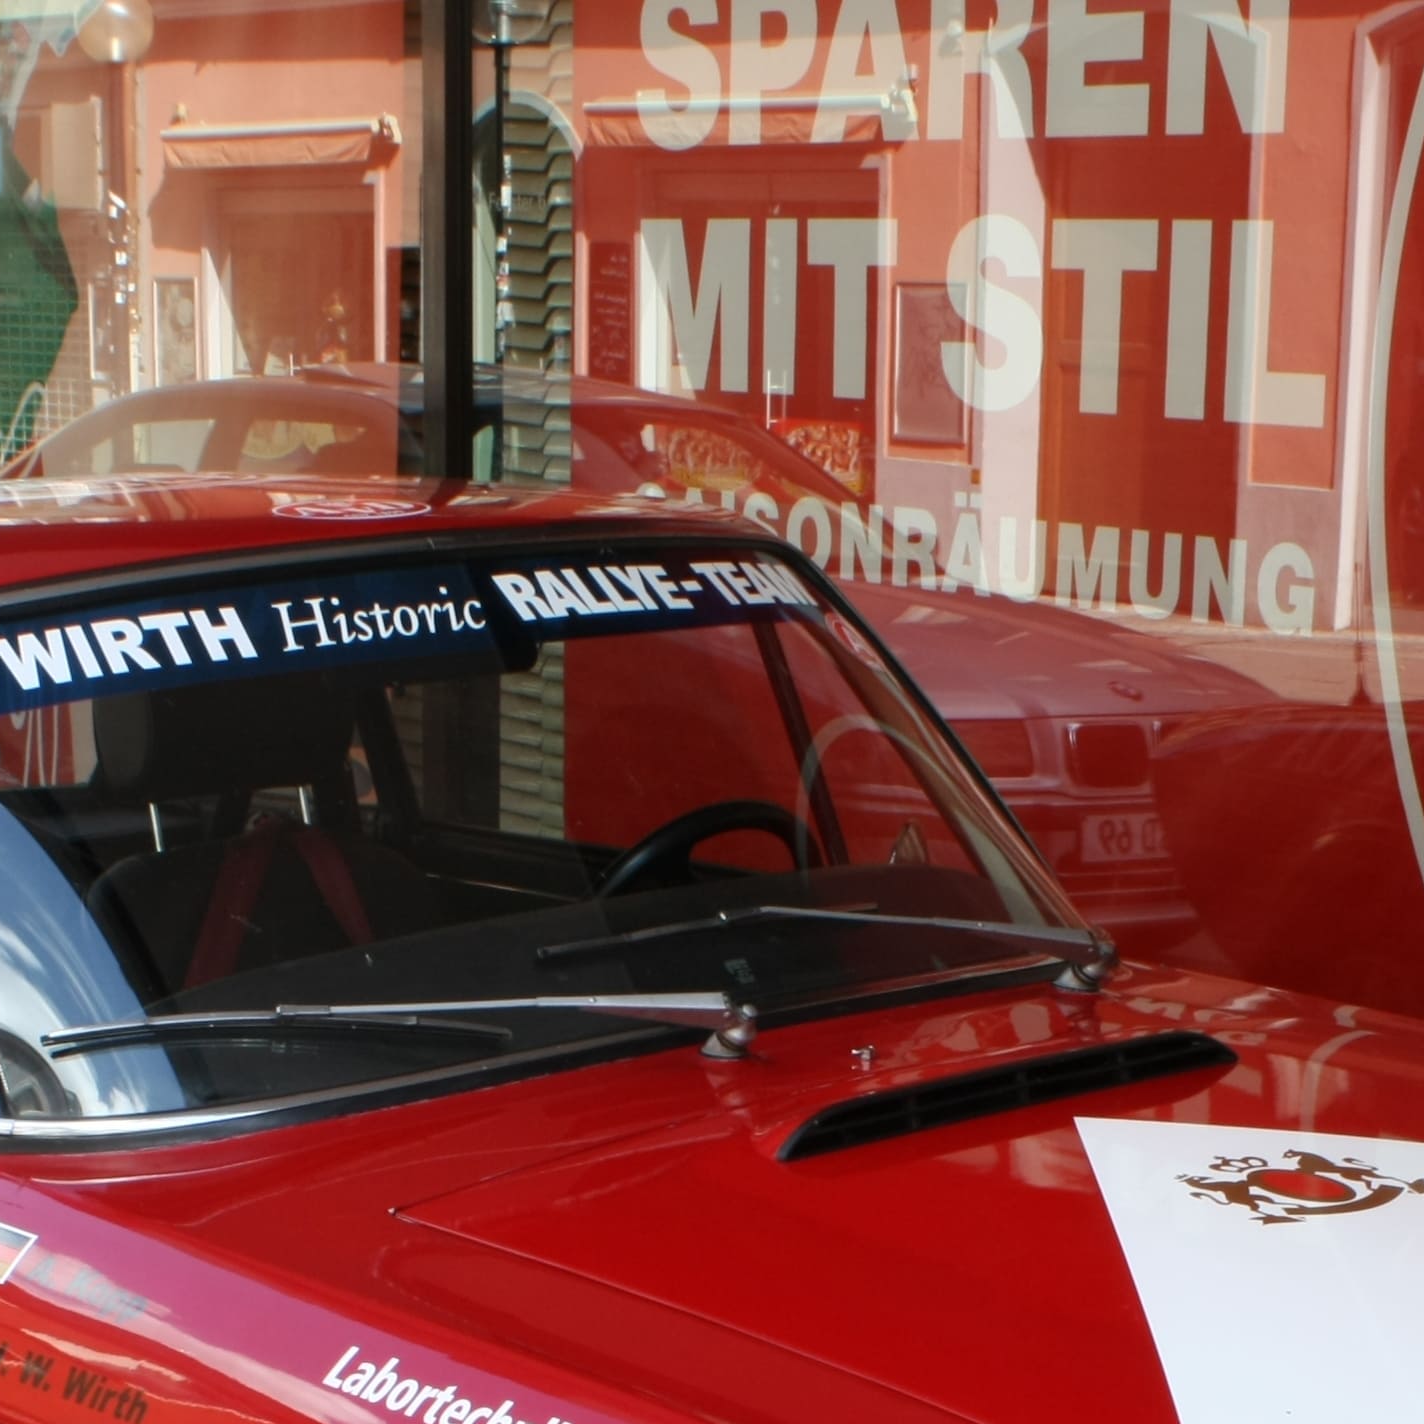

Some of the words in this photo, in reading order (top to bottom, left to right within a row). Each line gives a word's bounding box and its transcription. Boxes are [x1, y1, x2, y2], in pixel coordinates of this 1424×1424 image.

[633, 0, 1288, 153] SPAREN
[639, 216, 898, 400] MIT
[939, 213, 1328, 429] STIL
[271, 587, 489, 653] Historic
[636, 483, 1316, 636] ONRÄUMUNG
